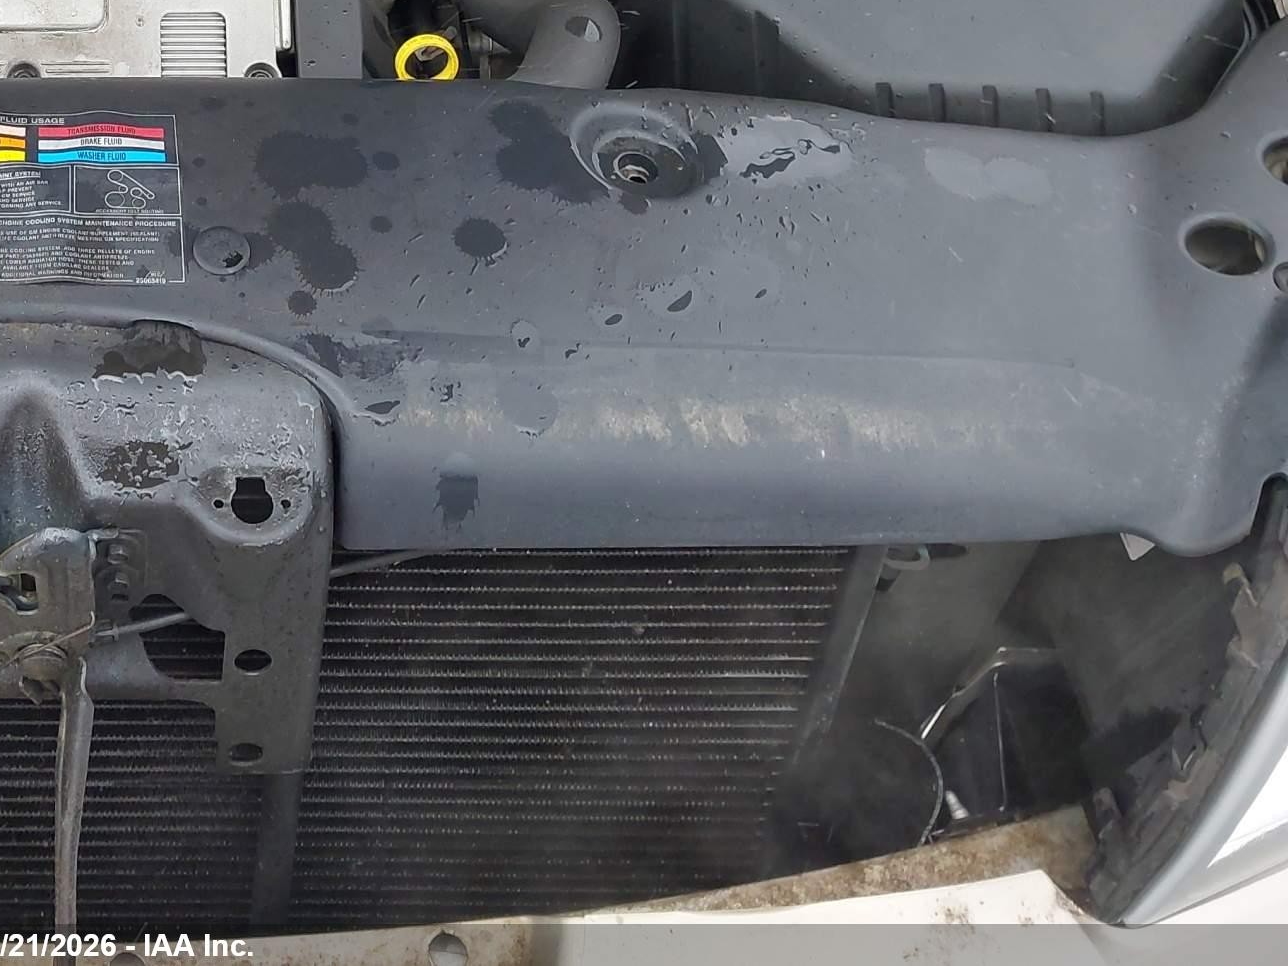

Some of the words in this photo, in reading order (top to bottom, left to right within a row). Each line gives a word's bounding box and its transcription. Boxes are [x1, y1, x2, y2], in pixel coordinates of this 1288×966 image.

[0, 115, 28, 124] FLUID
[31, 117, 65, 125] USAGE
[67, 125, 115, 135] TRANSMISSION
[117, 126, 136, 135] FLUID
[80, 137, 102, 146] BRAKE
[103, 137, 123, 146] FLUID
[77, 151, 106, 161] WASHER
[107, 151, 127, 161] FLUID
[25, 217, 55, 225] COOLING
[57, 217, 84, 226] SYSTEM
[84, 219, 133, 227] MAINTENANCE
